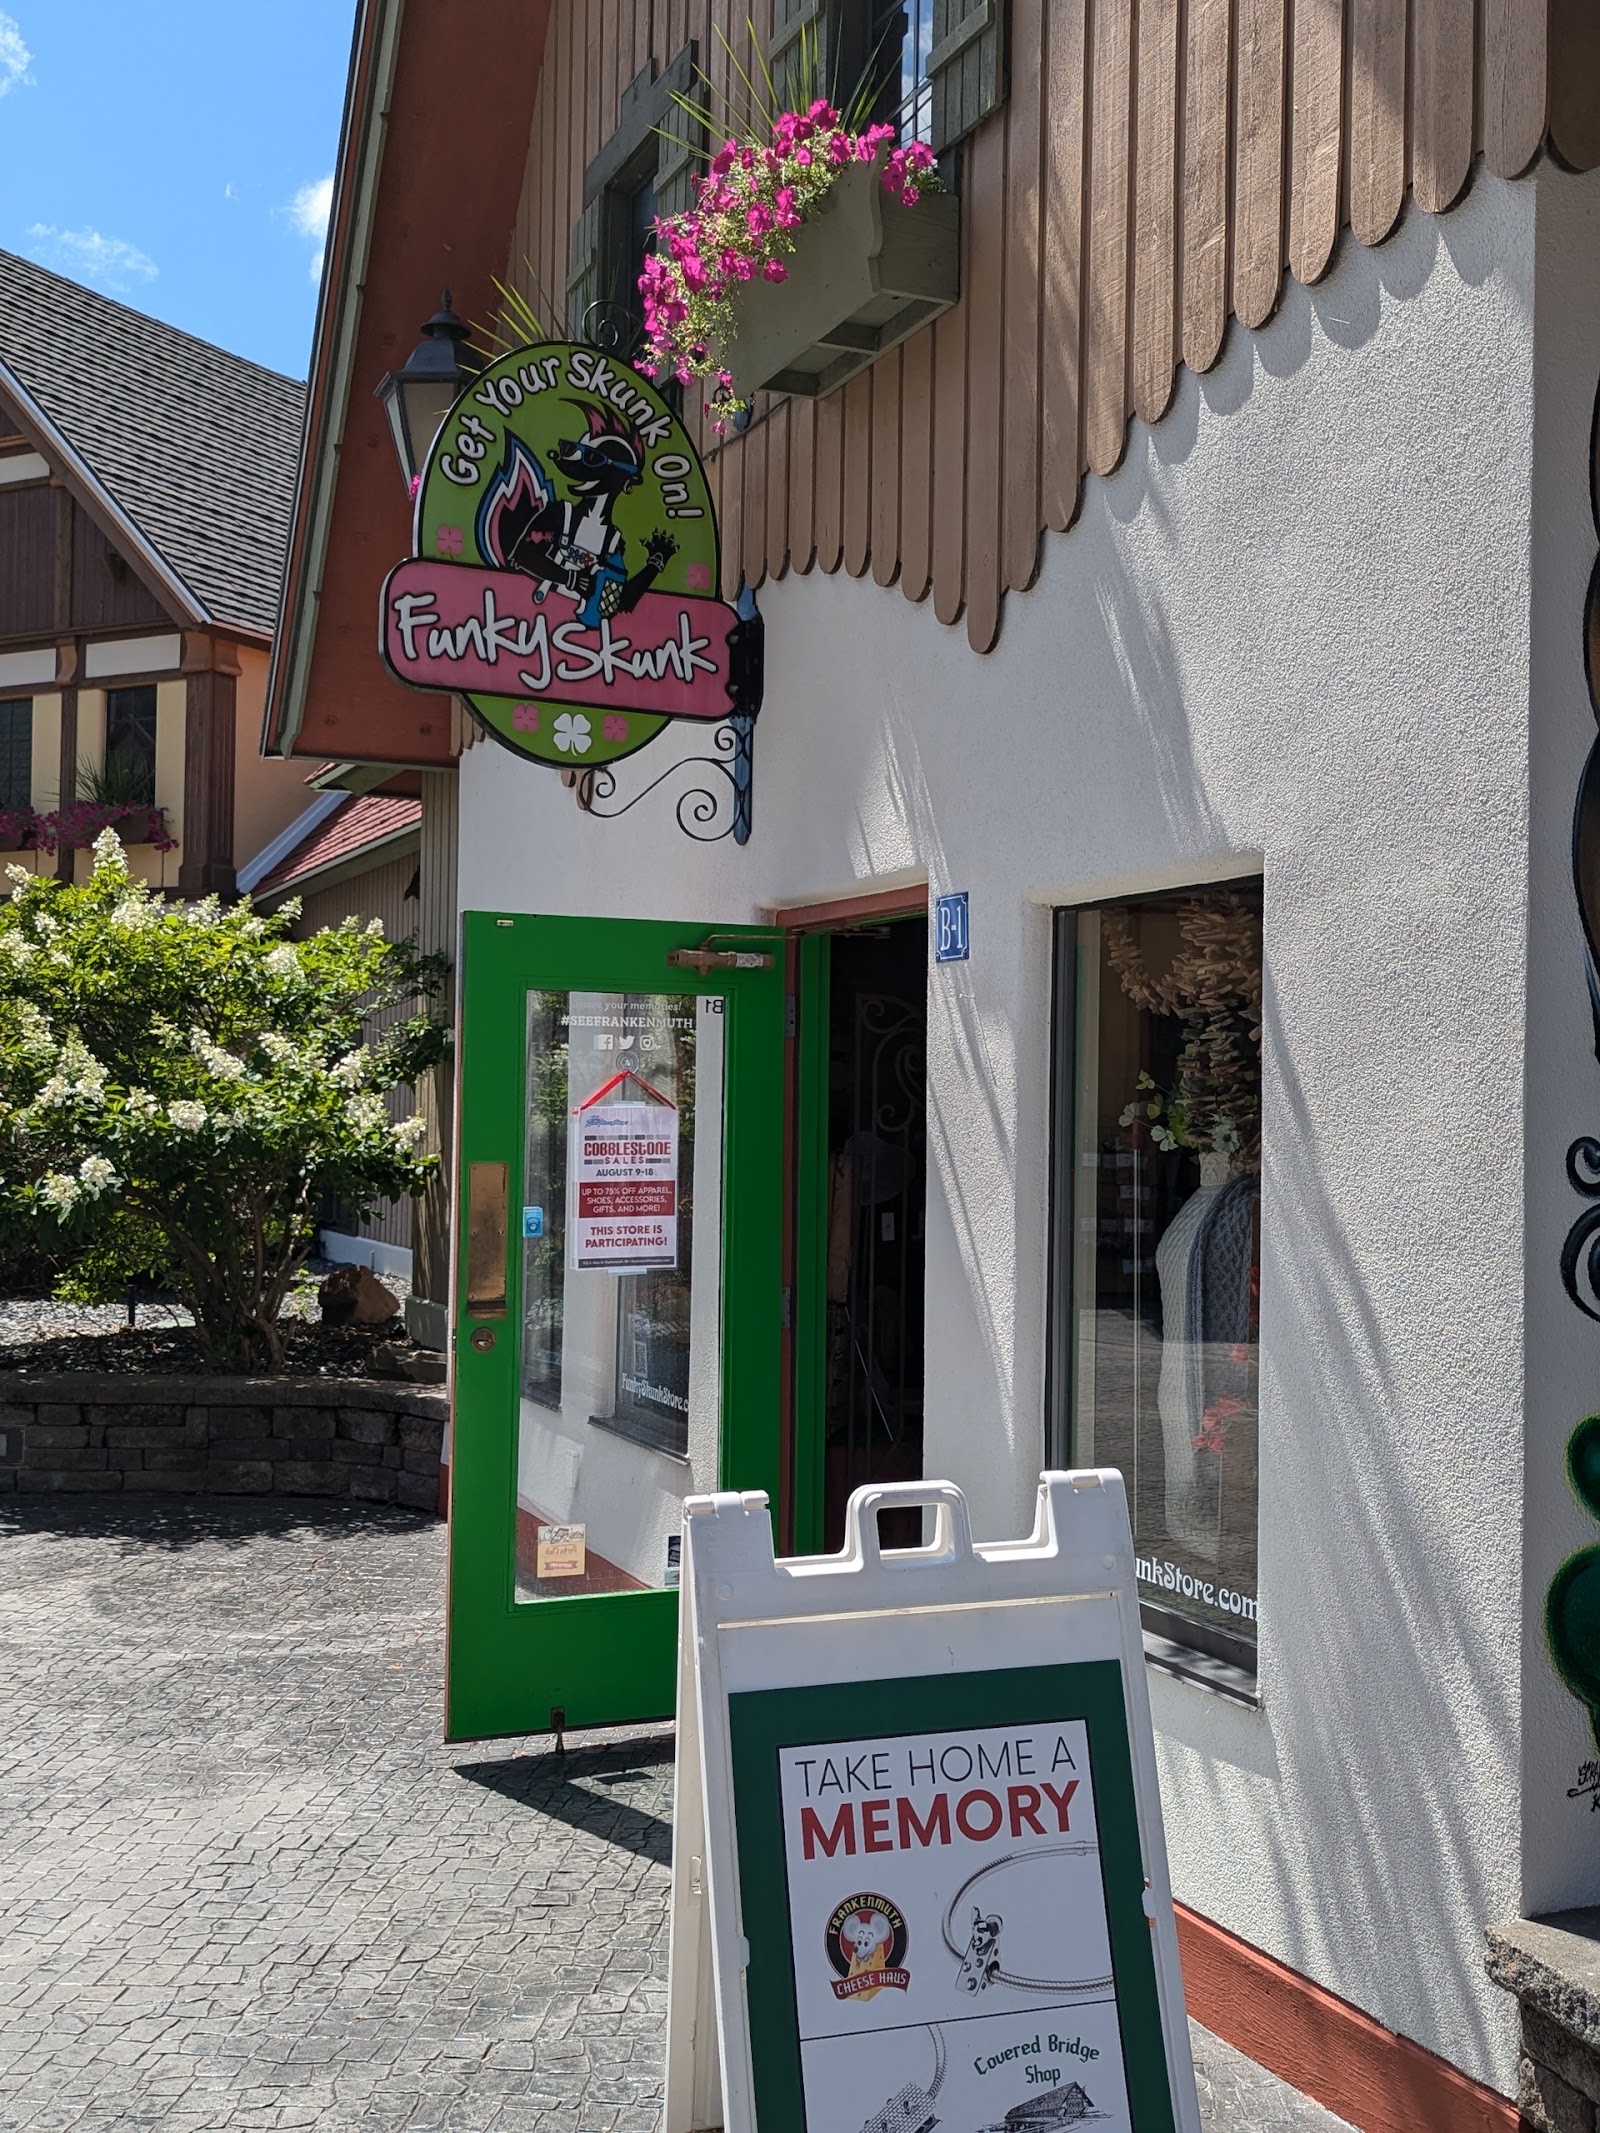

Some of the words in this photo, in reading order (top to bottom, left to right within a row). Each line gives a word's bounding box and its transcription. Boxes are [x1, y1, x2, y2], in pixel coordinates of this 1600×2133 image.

[441, 415, 496, 486] Get
[474, 356, 561, 417] Your
[567, 351, 671, 448] Skunk
[652, 453, 703, 521] On!
[940, 905, 963, 952] B-1
[604, 1002, 628, 1012] your
[561, 1015, 694, 1029] #SEEFRANKENMUTH
[604, 1156, 645, 1165] SALES
[596, 1168, 633, 1177] AUGUST
[635, 1167, 654, 1176] 9-18
[581, 1188, 592, 1196] UP
[605, 1187, 620, 1195] 75%
[621, 1187, 636, 1195] OFF
[637, 1186, 673, 1195] APPAREL,
[586, 1197, 614, 1205] SHOES,
[593, 1205, 616, 1213] GIFTS,
[617, 1205, 635, 1213] AND
[635, 1204, 661, 1212] MORE!
[590, 1226, 614, 1236] THIS
[616, 1225, 650, 1235] STORE
[653, 1224, 663, 1234] IS
[585, 1236, 668, 1248] PARTICIPATING!
[795, 1752, 892, 1798] TAKE
[909, 1738, 1036, 1787] HOME
[1051, 1736, 1077, 1773] A
[800, 1779, 1080, 1861] MEMORY
[829, 1895, 903, 1936] FRANKENMUTH
[837, 1973, 876, 1995] CHEESE
[879, 1971, 907, 1985] HAUS
[973, 2034, 1042, 2075] Covered
[1048, 2033, 1100, 2063] Bridge
[1025, 2064, 1061, 2088] Shop
